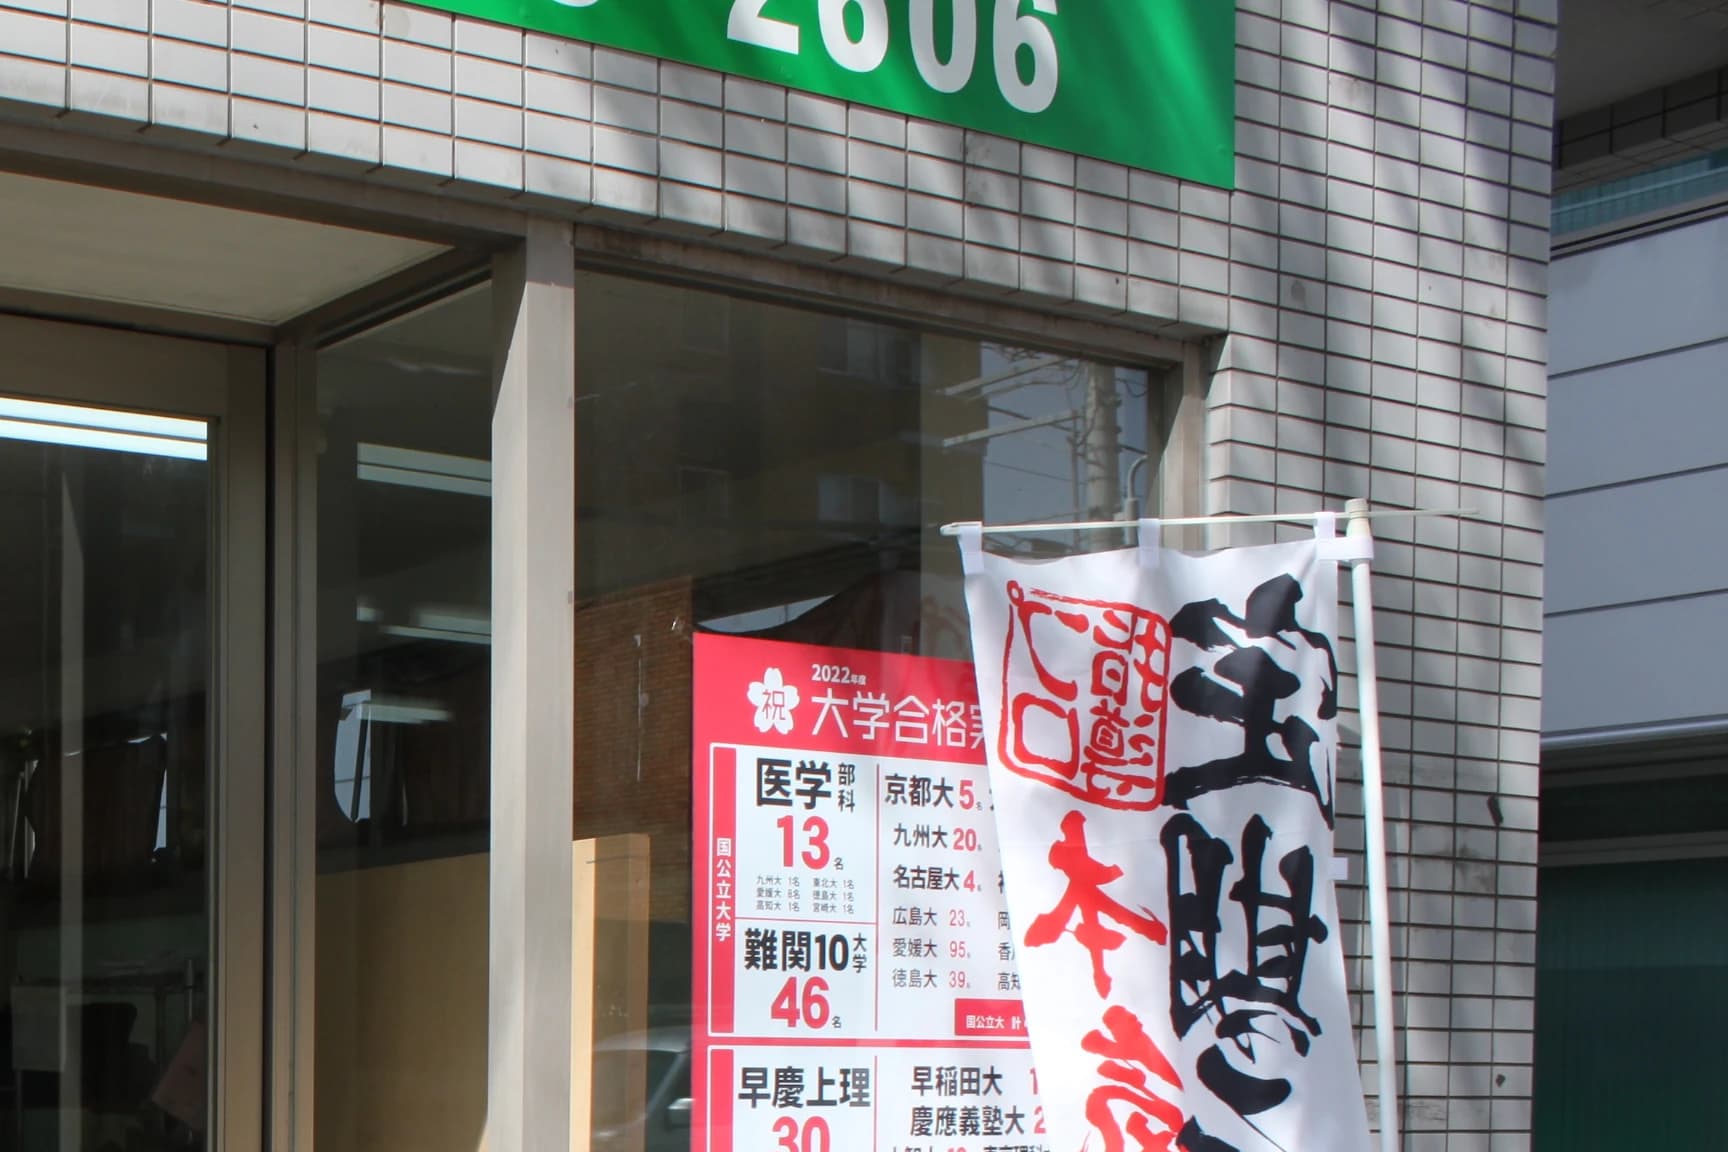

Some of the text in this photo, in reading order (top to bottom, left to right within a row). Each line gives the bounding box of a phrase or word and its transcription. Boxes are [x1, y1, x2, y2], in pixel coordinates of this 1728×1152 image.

[761, 689, 786, 721] 祝
[884, 773, 954, 808] 京都大
[893, 823, 948, 849] 九州大
[715, 837, 732, 942] 国公立大学
[893, 864, 960, 891] 名古屋大
[892, 906, 938, 927] 広島大
[892, 937, 938, 958] 愛媛大
[892, 968, 938, 989] 徳島大
[738, 1065, 871, 1109] 早慶上理
[911, 1065, 1003, 1097] 早稲田大
[910, 1105, 1025, 1137] 慶應義塾大
